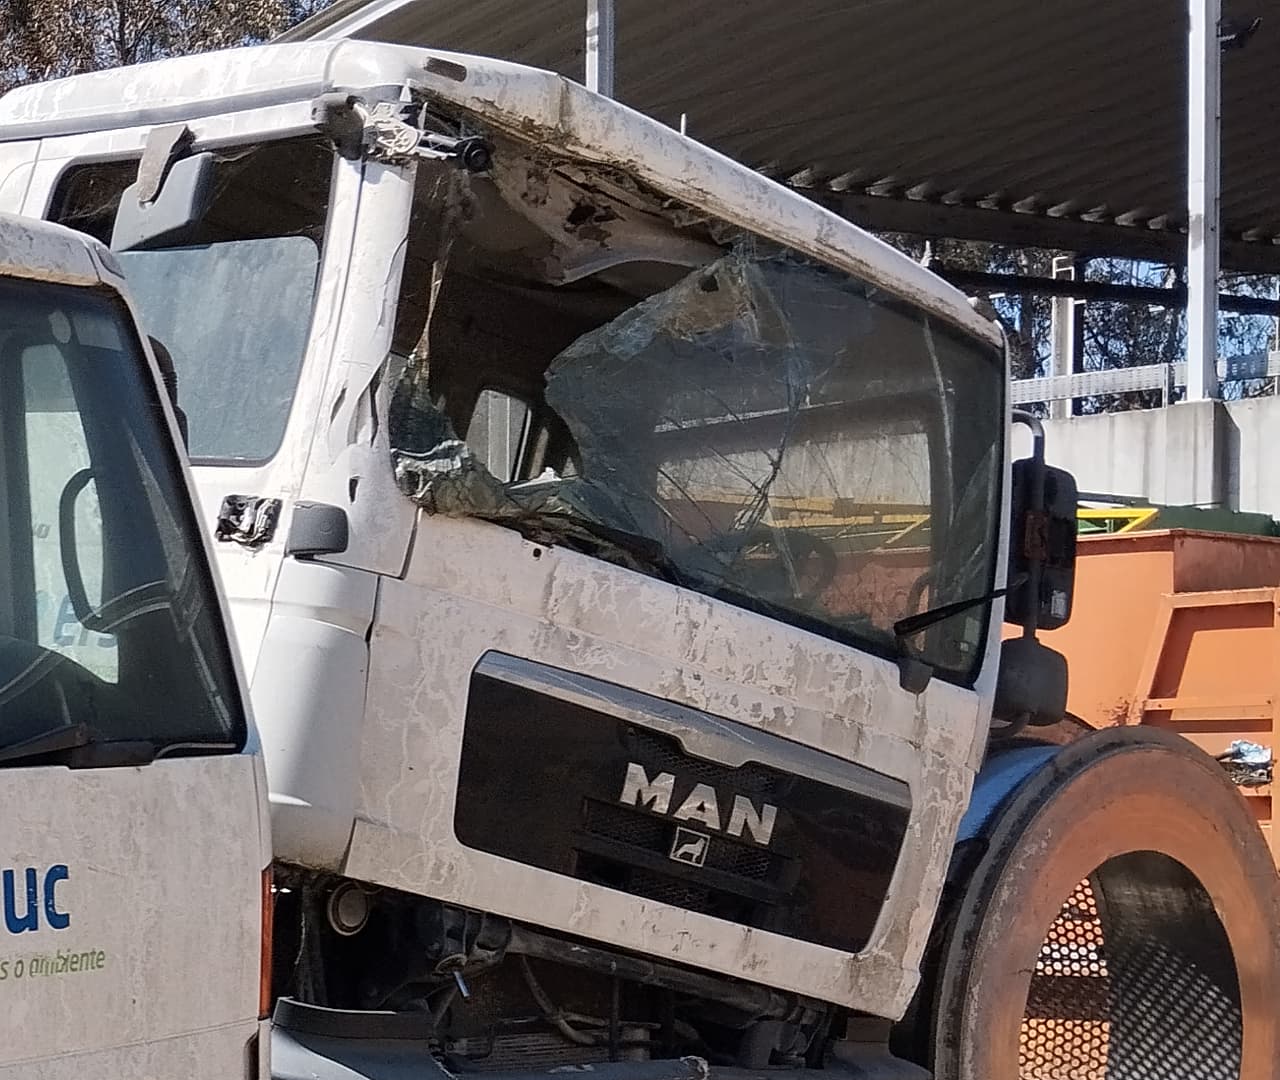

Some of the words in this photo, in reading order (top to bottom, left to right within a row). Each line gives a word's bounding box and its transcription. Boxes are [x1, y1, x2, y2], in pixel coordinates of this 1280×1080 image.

[620, 762, 777, 845] MAN
[14, 959, 24, 978] o
[28, 948, 106, 978] ambiente
